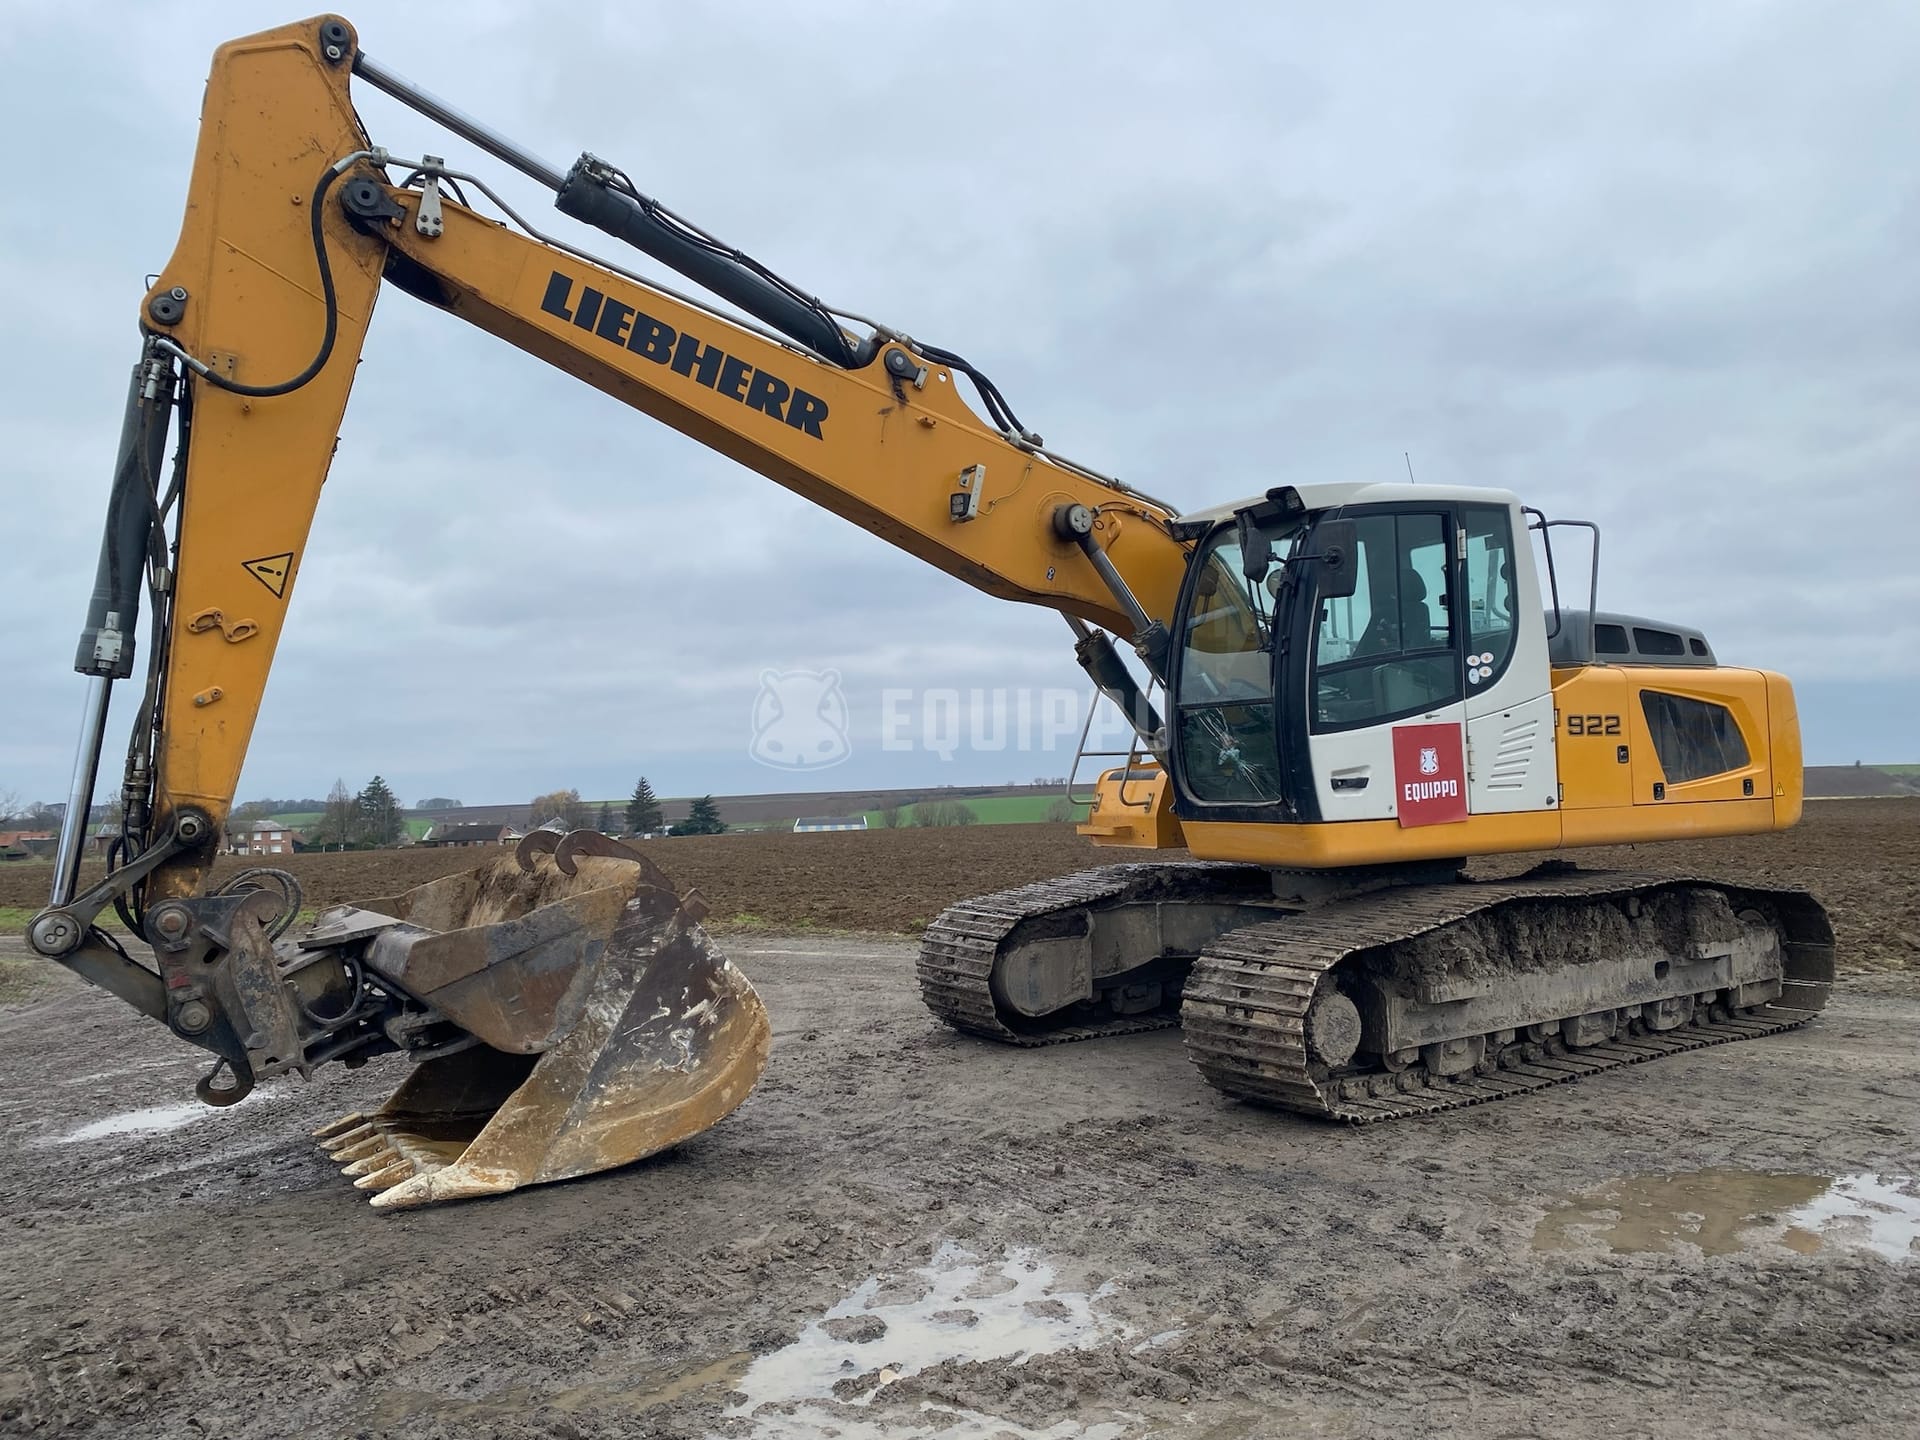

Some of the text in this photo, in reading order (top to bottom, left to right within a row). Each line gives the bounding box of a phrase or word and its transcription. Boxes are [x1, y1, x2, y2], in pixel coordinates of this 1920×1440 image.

[541, 270, 829, 441] LIEBHERR
[1567, 714, 1621, 736] 922
[1404, 779, 1458, 803] EQUIPPO
